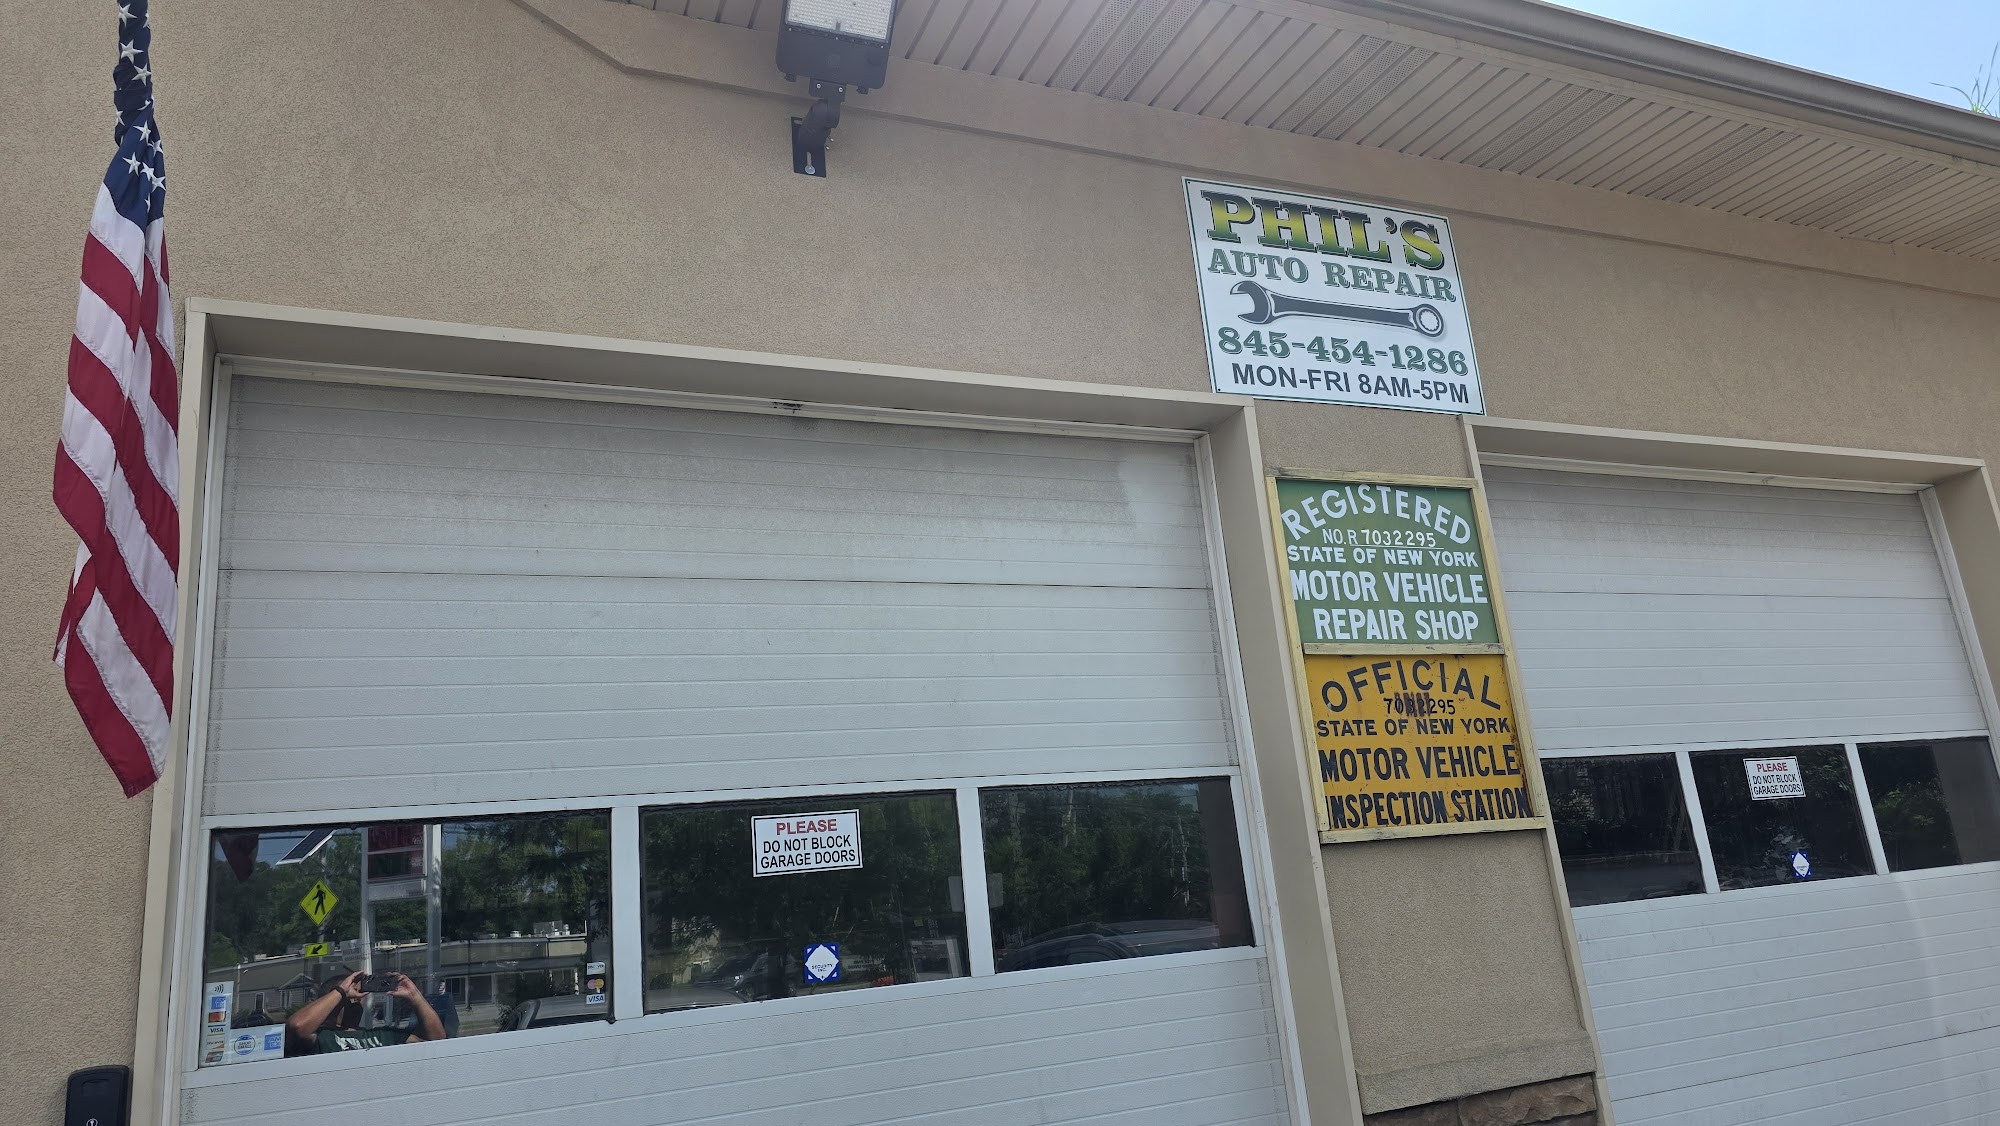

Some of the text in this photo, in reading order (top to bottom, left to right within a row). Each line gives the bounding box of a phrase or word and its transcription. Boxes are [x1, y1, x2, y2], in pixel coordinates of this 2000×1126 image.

[1200, 190, 1445, 270] PHIL'S
[1208, 248, 1457, 302] AUTO REPAIR
[1217, 326, 1469, 377] 845-454-1286
[1232, 363, 1469, 403] MON-FRI 8AM-5PM
[1281, 484, 1471, 544] REGISTERED
[1361, 529, 1437, 547] 7032295
[1287, 545, 1479, 567] STATE OF NEW YORK
[1289, 570, 1488, 604] MOTOR VEHICLE
[1313, 608, 1479, 641] REPAIR SHOP
[1321, 660, 1501, 712] OFFICIAL
[1317, 717, 1511, 737] STATE OF NEW YORK
[1319, 744, 1521, 782] MOTOR VEHICLE
[1756, 762, 1788, 773] PLEASE
[1752, 773, 1797, 785] DO NOT BLOCK
[1753, 783, 1802, 795] GARAGE DOORS
[1450, 787, 1534, 823] STATION
[776, 818, 838, 836] PLEASE
[763, 834, 851, 854] DO NOT BLOCK
[760, 849, 856, 869] GARAGE DOORS
[588, 995, 604, 1003] VISA
